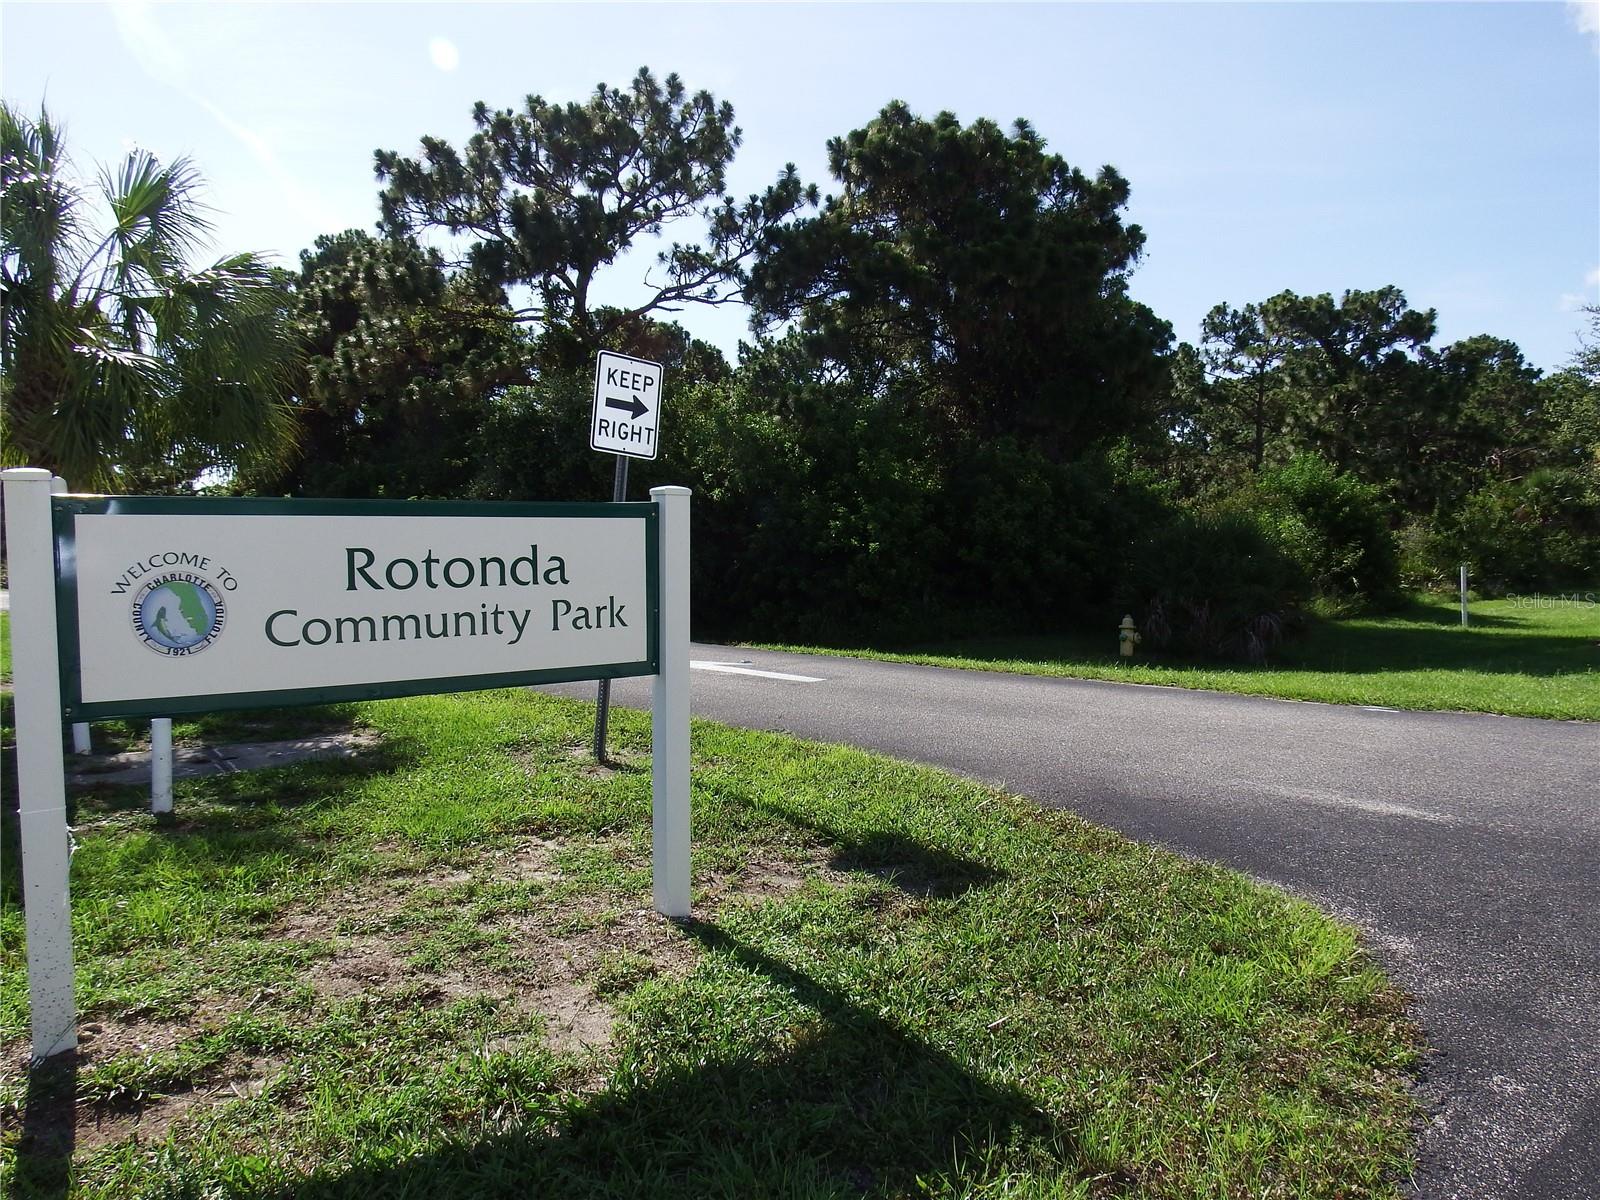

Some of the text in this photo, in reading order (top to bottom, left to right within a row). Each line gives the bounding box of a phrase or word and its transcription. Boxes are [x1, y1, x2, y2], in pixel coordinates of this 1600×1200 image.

[607, 367, 654, 392] KEEP
[598, 419, 654, 445] RIGHT
[111, 552, 238, 595] WELCOME TO
[146, 573, 213, 591] CHARLOTTE
[345, 544, 570, 591] Rotonda
[204, 601, 225, 644] FLORIDA
[265, 596, 628, 647] Community Park
[167, 647, 192, 656] 1921
